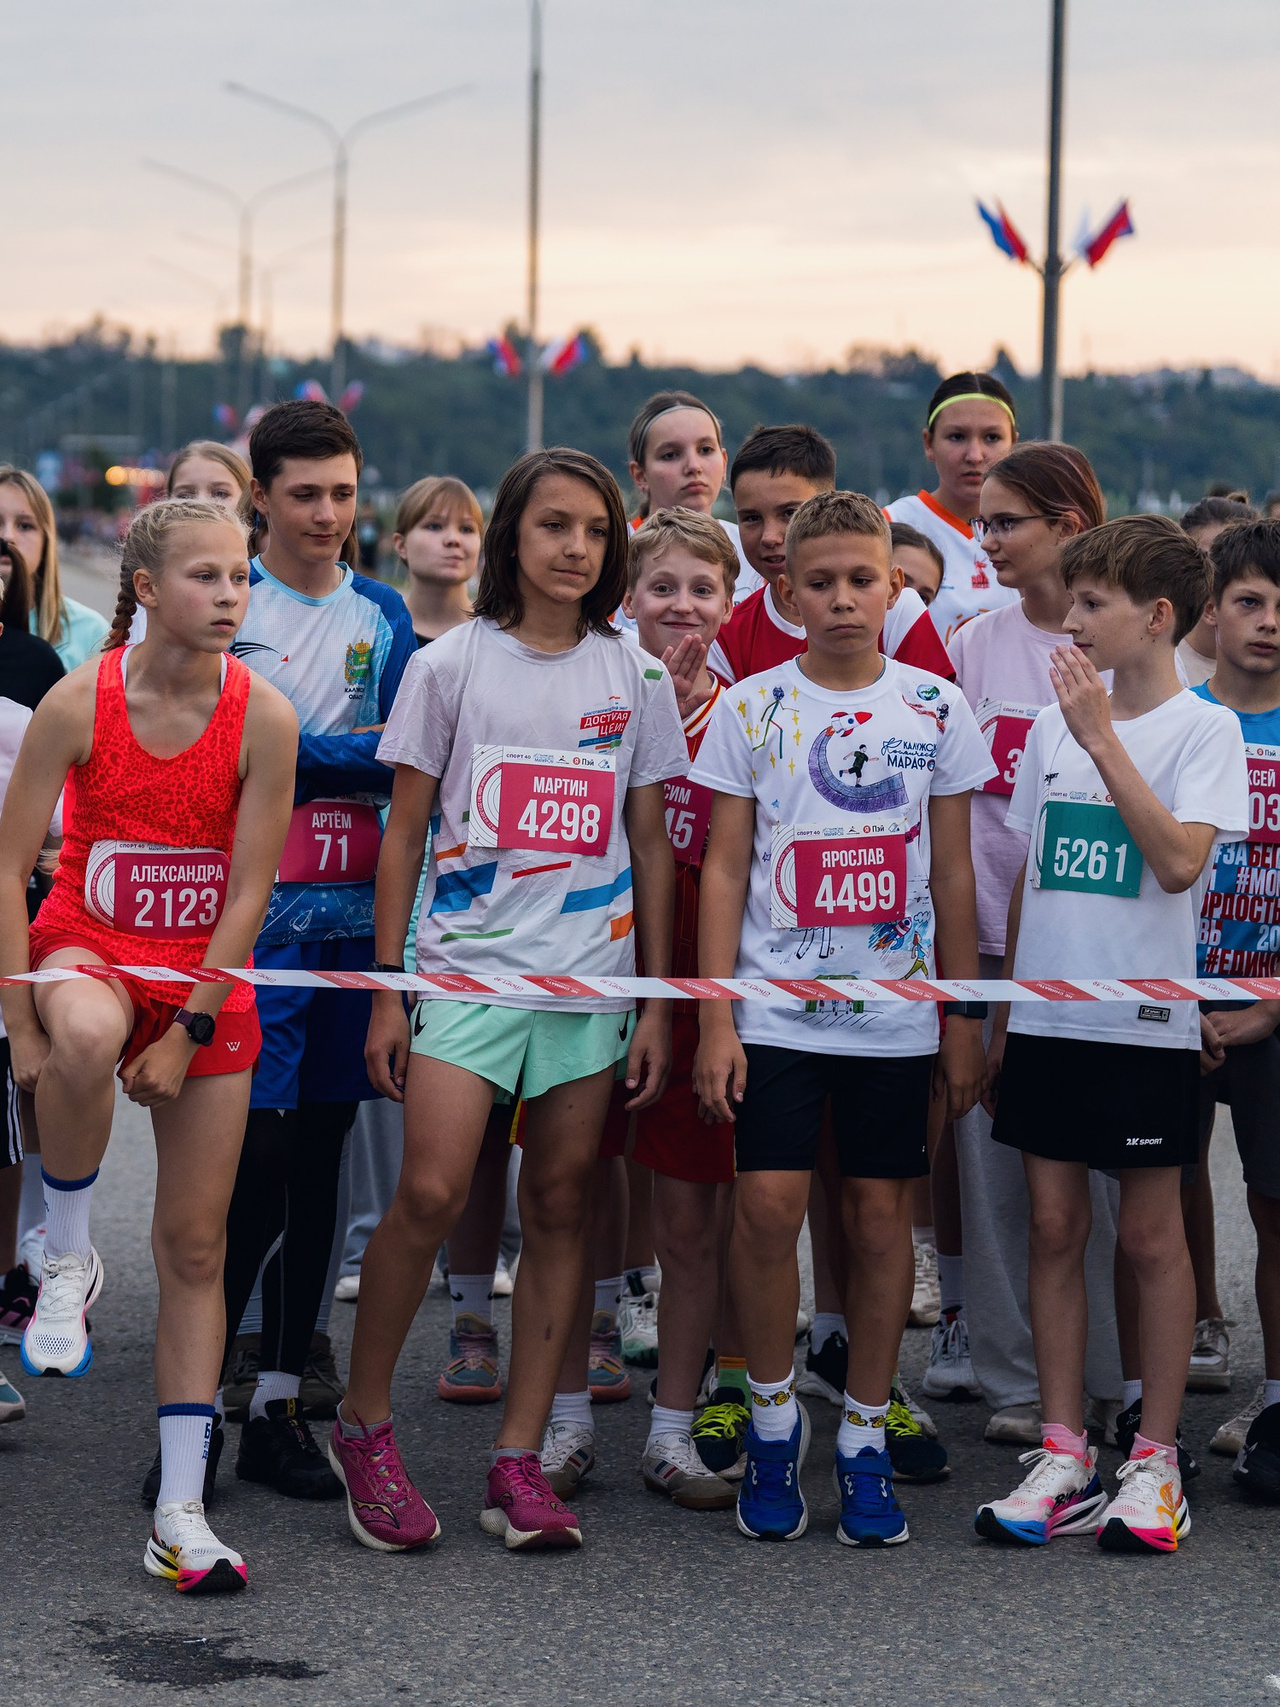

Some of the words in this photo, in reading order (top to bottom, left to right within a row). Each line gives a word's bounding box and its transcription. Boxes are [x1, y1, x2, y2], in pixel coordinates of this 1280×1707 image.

[1003, 747, 1024, 784] 3
[533, 776, 588, 797] МАРТИН
[311, 810, 352, 829] АРТЁМ
[517, 798, 601, 844] 4298
[1248, 791, 1280, 832] 03
[314, 834, 348, 871] 71
[821, 847, 885, 868] ЯРОСЛАВ
[1053, 836, 1129, 883] 5261
[130, 864, 225, 883] АЛЕКСАНДРА
[814, 870, 896, 914] 4499
[1236, 866, 1280, 897] #МО
[134, 887, 219, 928] 2123
[1139, 1137, 1163, 1146] SPORT
